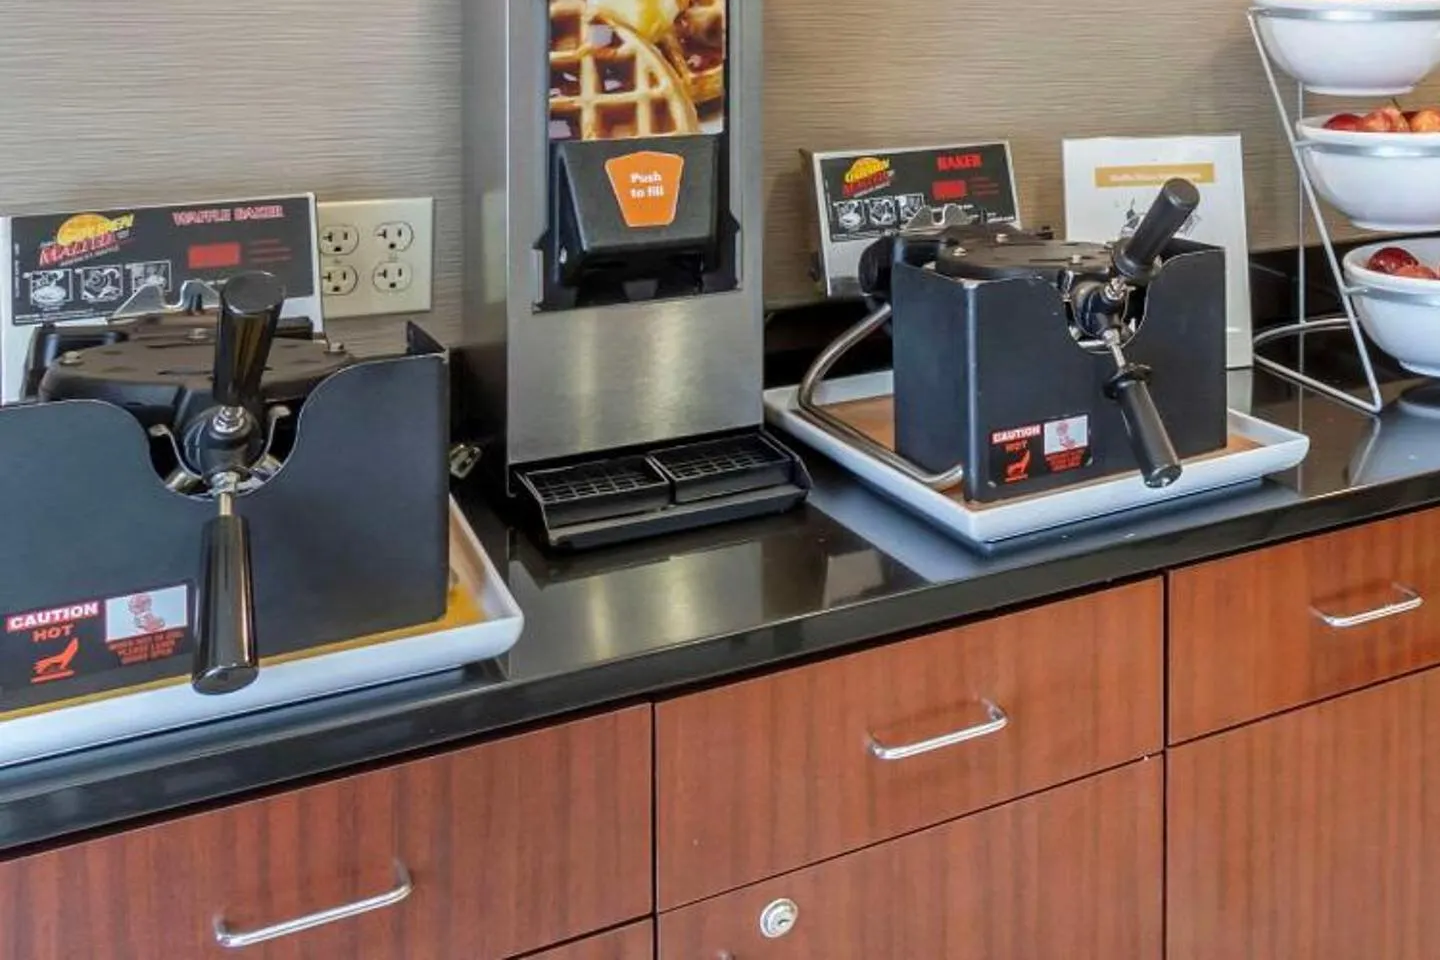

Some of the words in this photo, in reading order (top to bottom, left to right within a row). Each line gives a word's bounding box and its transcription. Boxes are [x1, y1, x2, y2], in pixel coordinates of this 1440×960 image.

[629, 170, 662, 184] Push
[630, 187, 646, 199] to
[647, 184, 665, 197] fill
[171, 207, 232, 227] WAFFLE
[991, 423, 1042, 445] CAUTION
[6, 601, 100, 633] CAUTION
[32, 623, 75, 643] HOT
